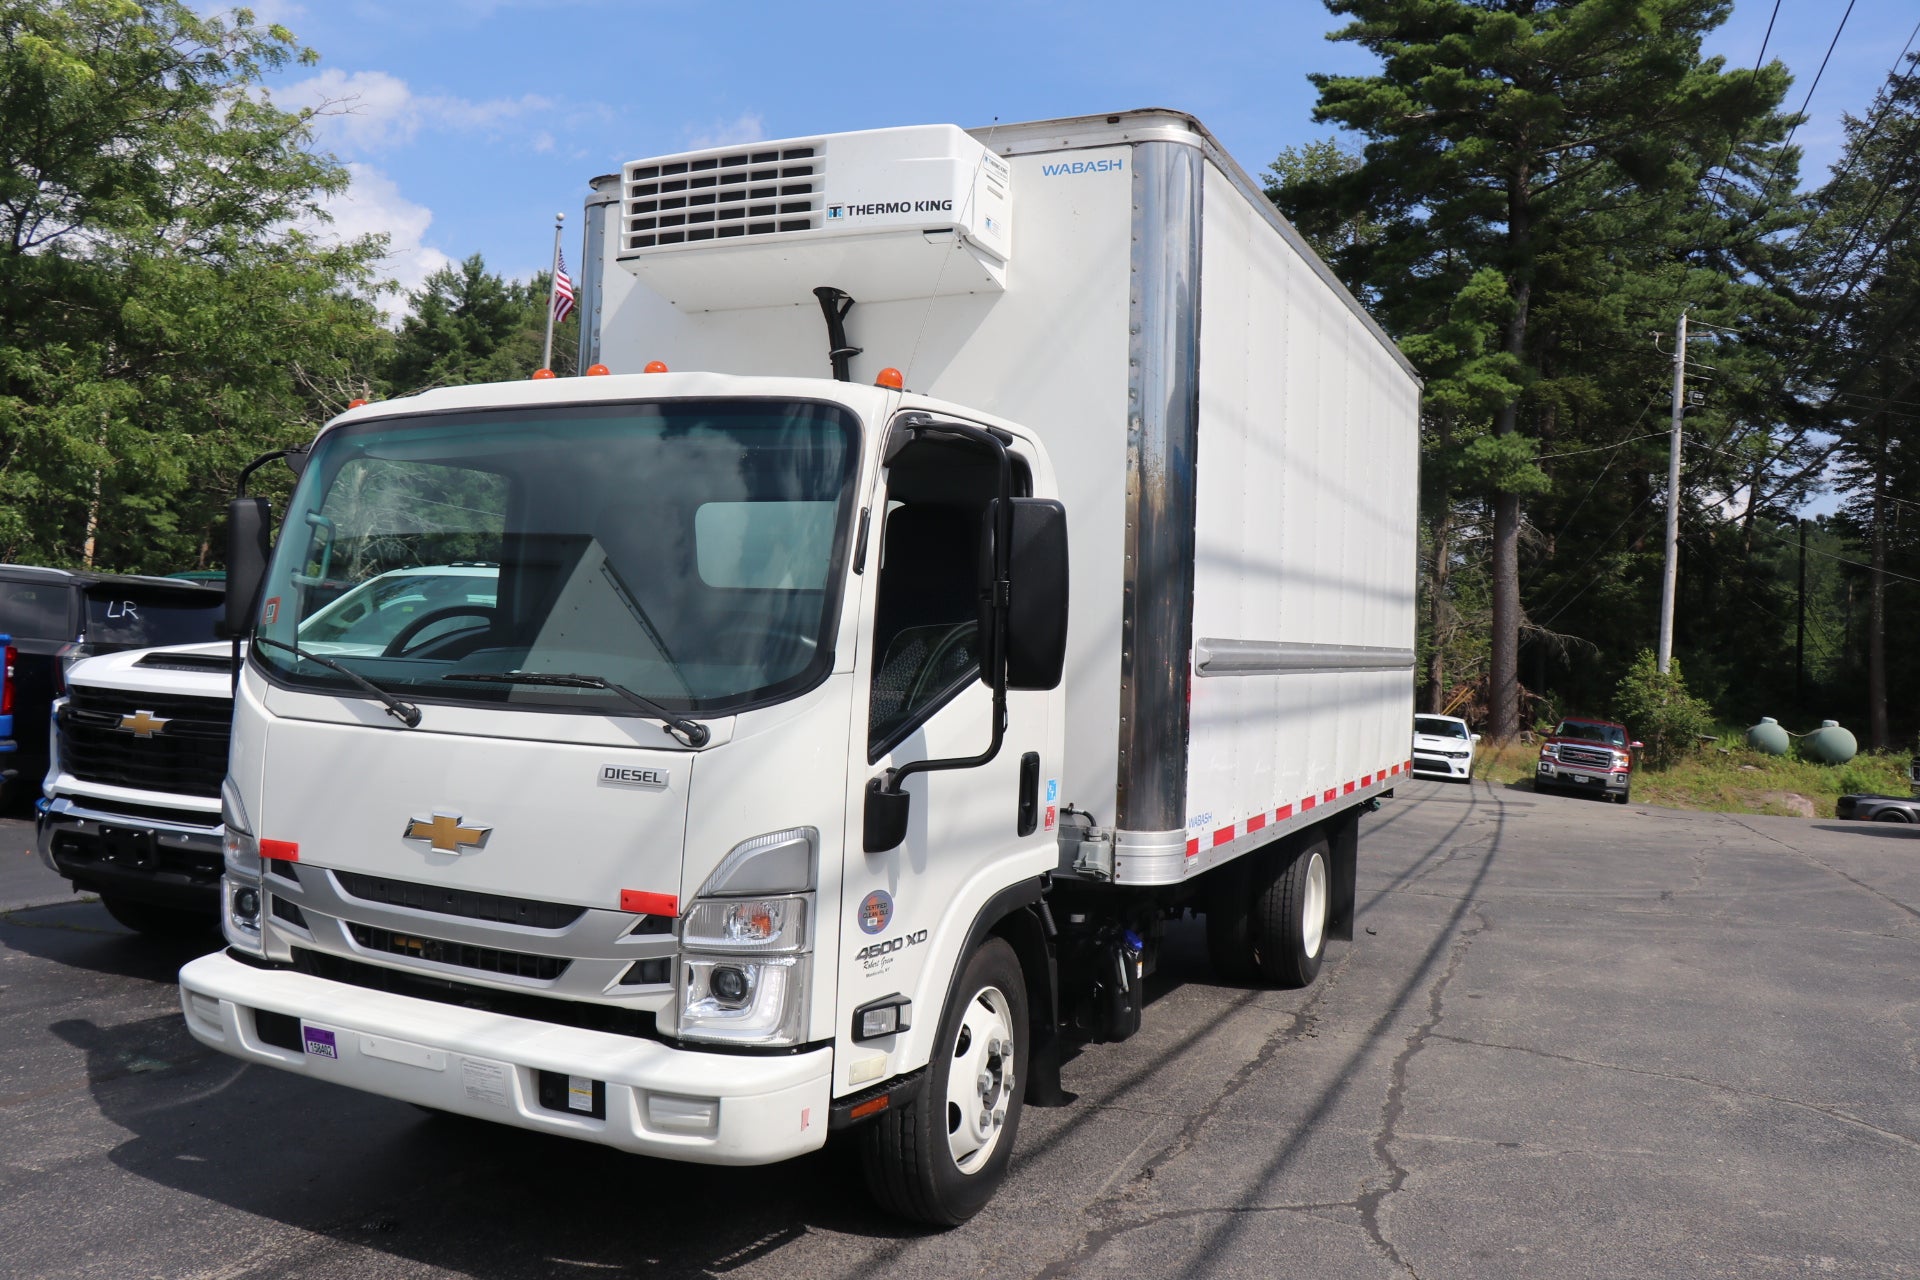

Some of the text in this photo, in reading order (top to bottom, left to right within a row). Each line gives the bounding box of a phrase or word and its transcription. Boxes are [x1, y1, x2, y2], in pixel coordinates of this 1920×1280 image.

[1042, 159, 1123, 176] WABASH
[847, 199, 953, 216] THERMO KING
[107, 600, 139, 620] LR
[604, 767, 662, 784] DIESEL
[1188, 811, 1213, 829] WABASH
[863, 911, 879, 919] CLEAN
[854, 929, 928, 961] 4500 XD
[863, 956, 894, 970] Robert Green
